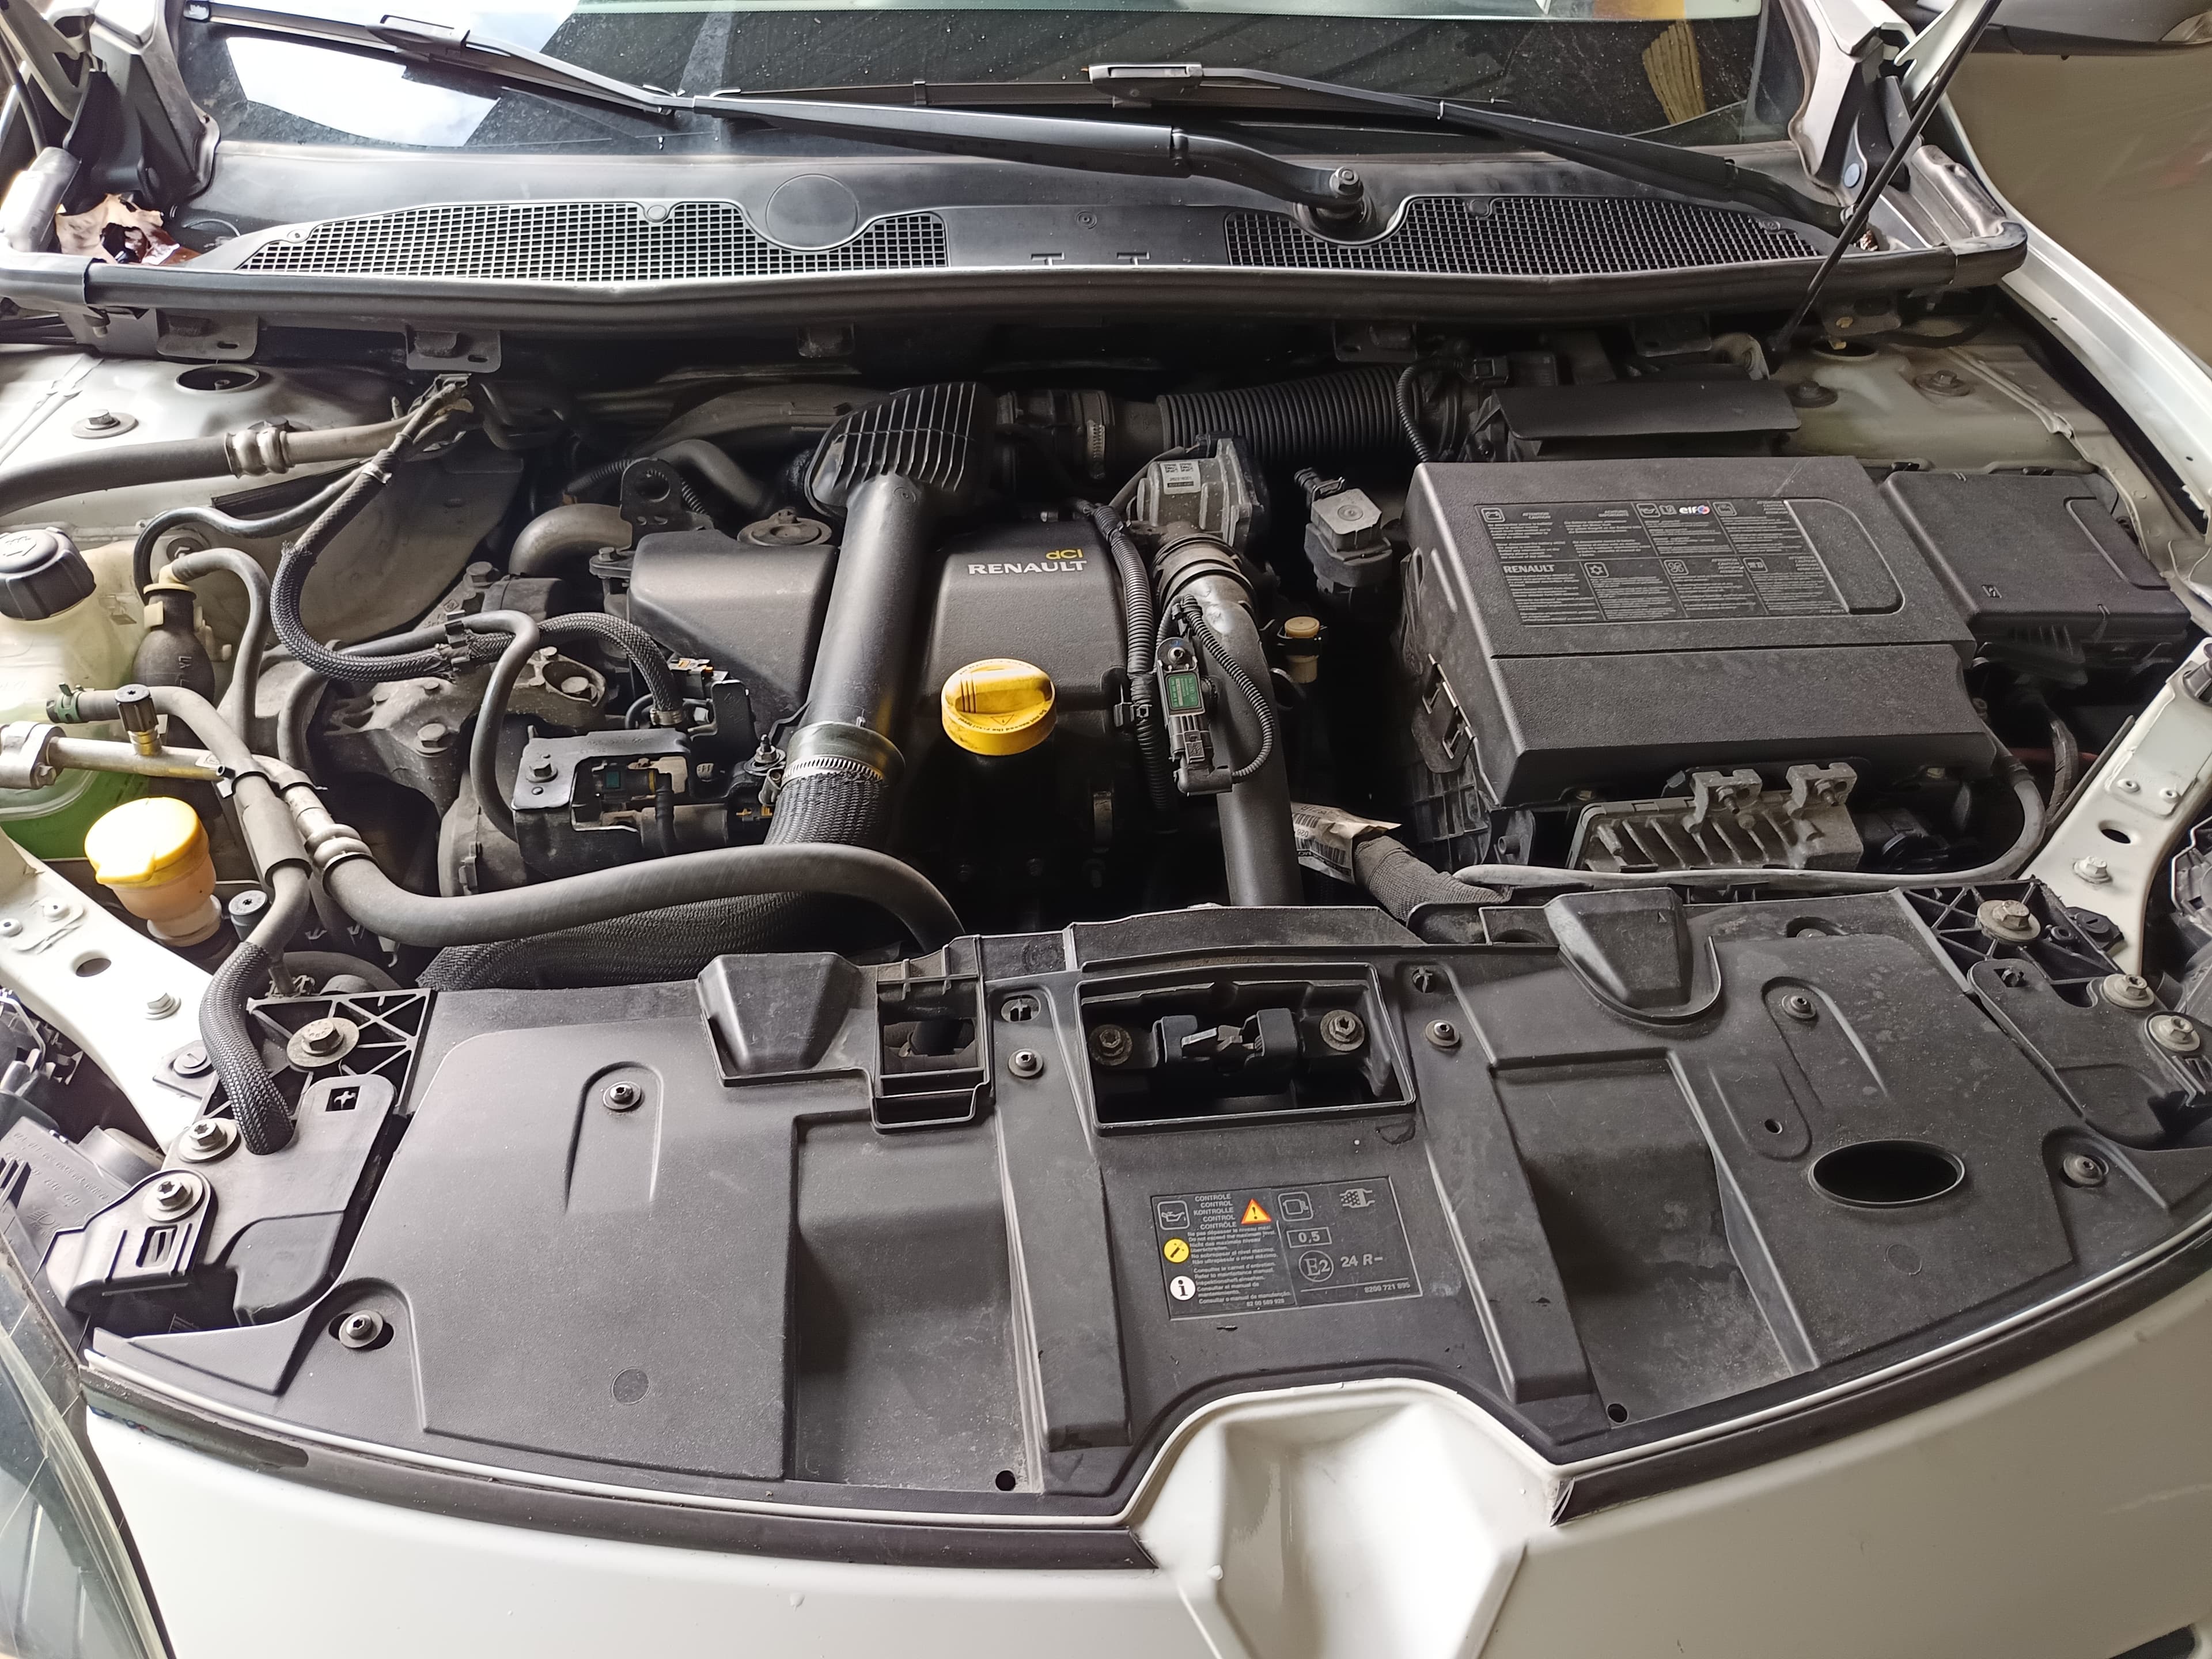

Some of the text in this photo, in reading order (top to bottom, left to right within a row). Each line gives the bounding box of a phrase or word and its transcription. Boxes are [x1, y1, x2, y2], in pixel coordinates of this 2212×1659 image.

[1679, 506, 1698, 514] elf
[967, 560, 1087, 575] RENAULT
[1502, 564, 1555, 573] RENAULT
[1195, 1194, 1231, 1202] CONTROLE
[1193, 1207, 1234, 1215] KONTROLLE
[1203, 1214, 1236, 1222] CONTROL
[1200, 1221, 1237, 1230] CONTRÔLE
[1298, 1231, 1321, 1244] 0,5
[1340, 1255, 1359, 1268] 24
[1304, 1257, 1331, 1277] E2
